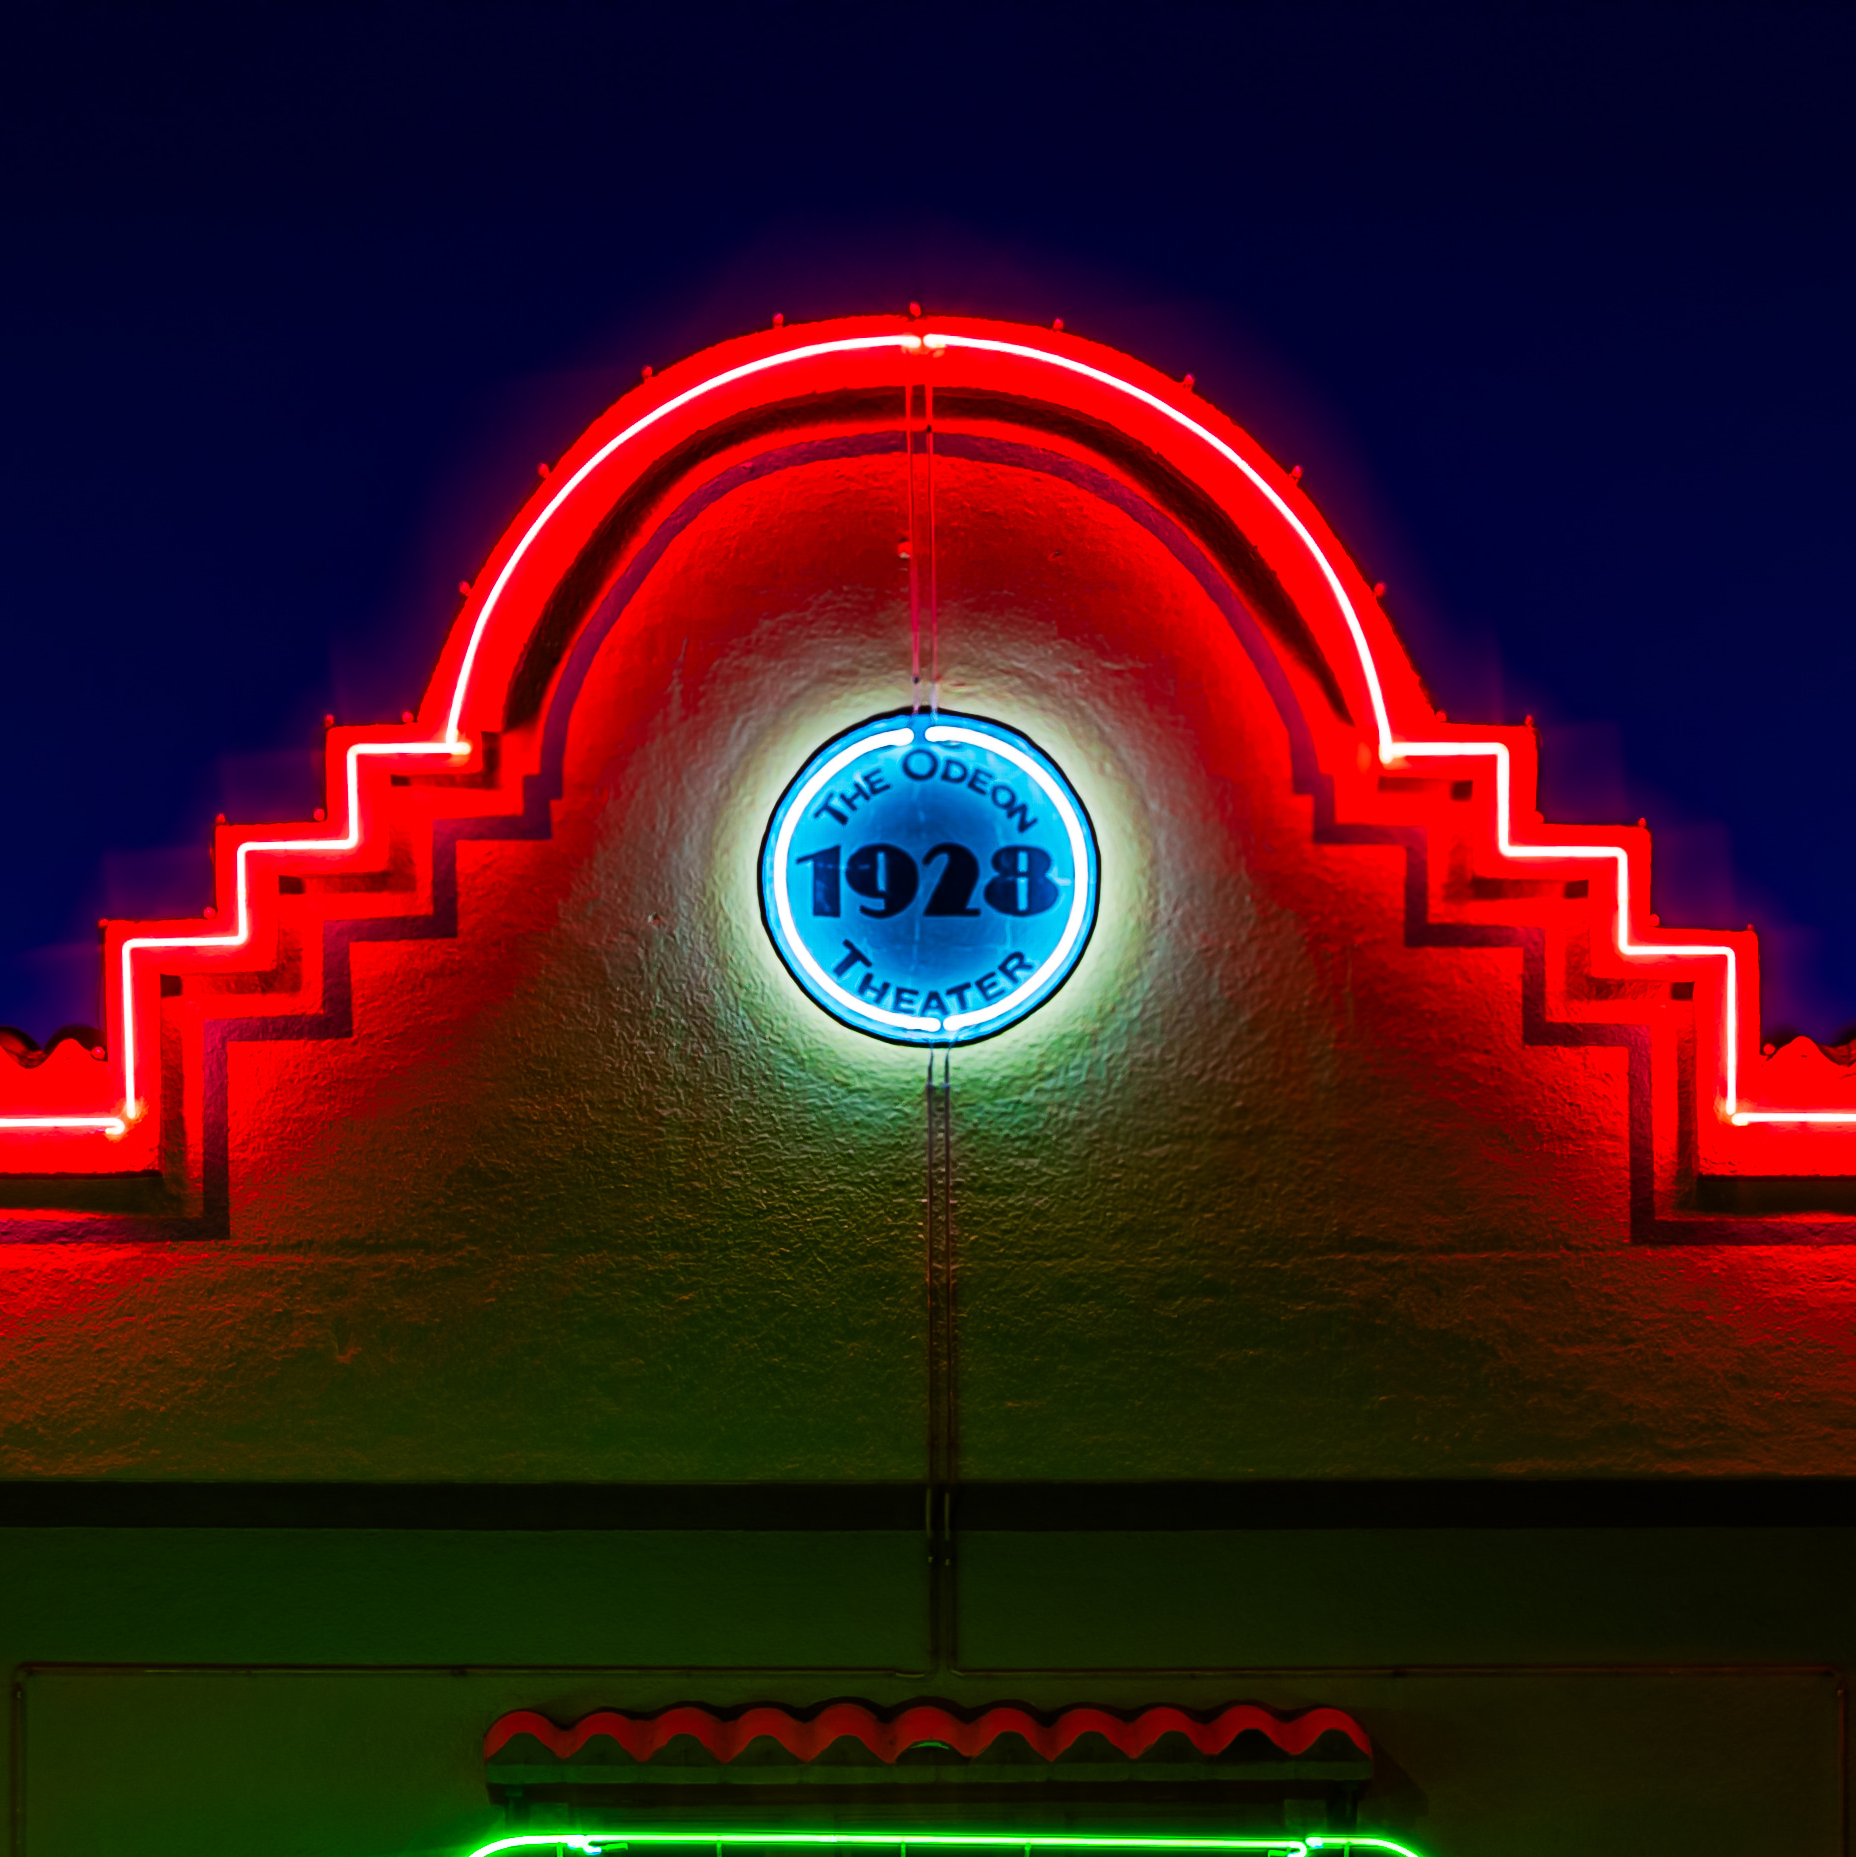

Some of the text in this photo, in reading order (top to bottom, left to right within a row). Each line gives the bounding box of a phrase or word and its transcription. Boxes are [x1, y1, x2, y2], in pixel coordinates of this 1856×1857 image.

[813, 748, 1039, 834] THE ODEON
[796, 842, 1059, 919] 1928
[831, 938, 1035, 1017] THEATER
